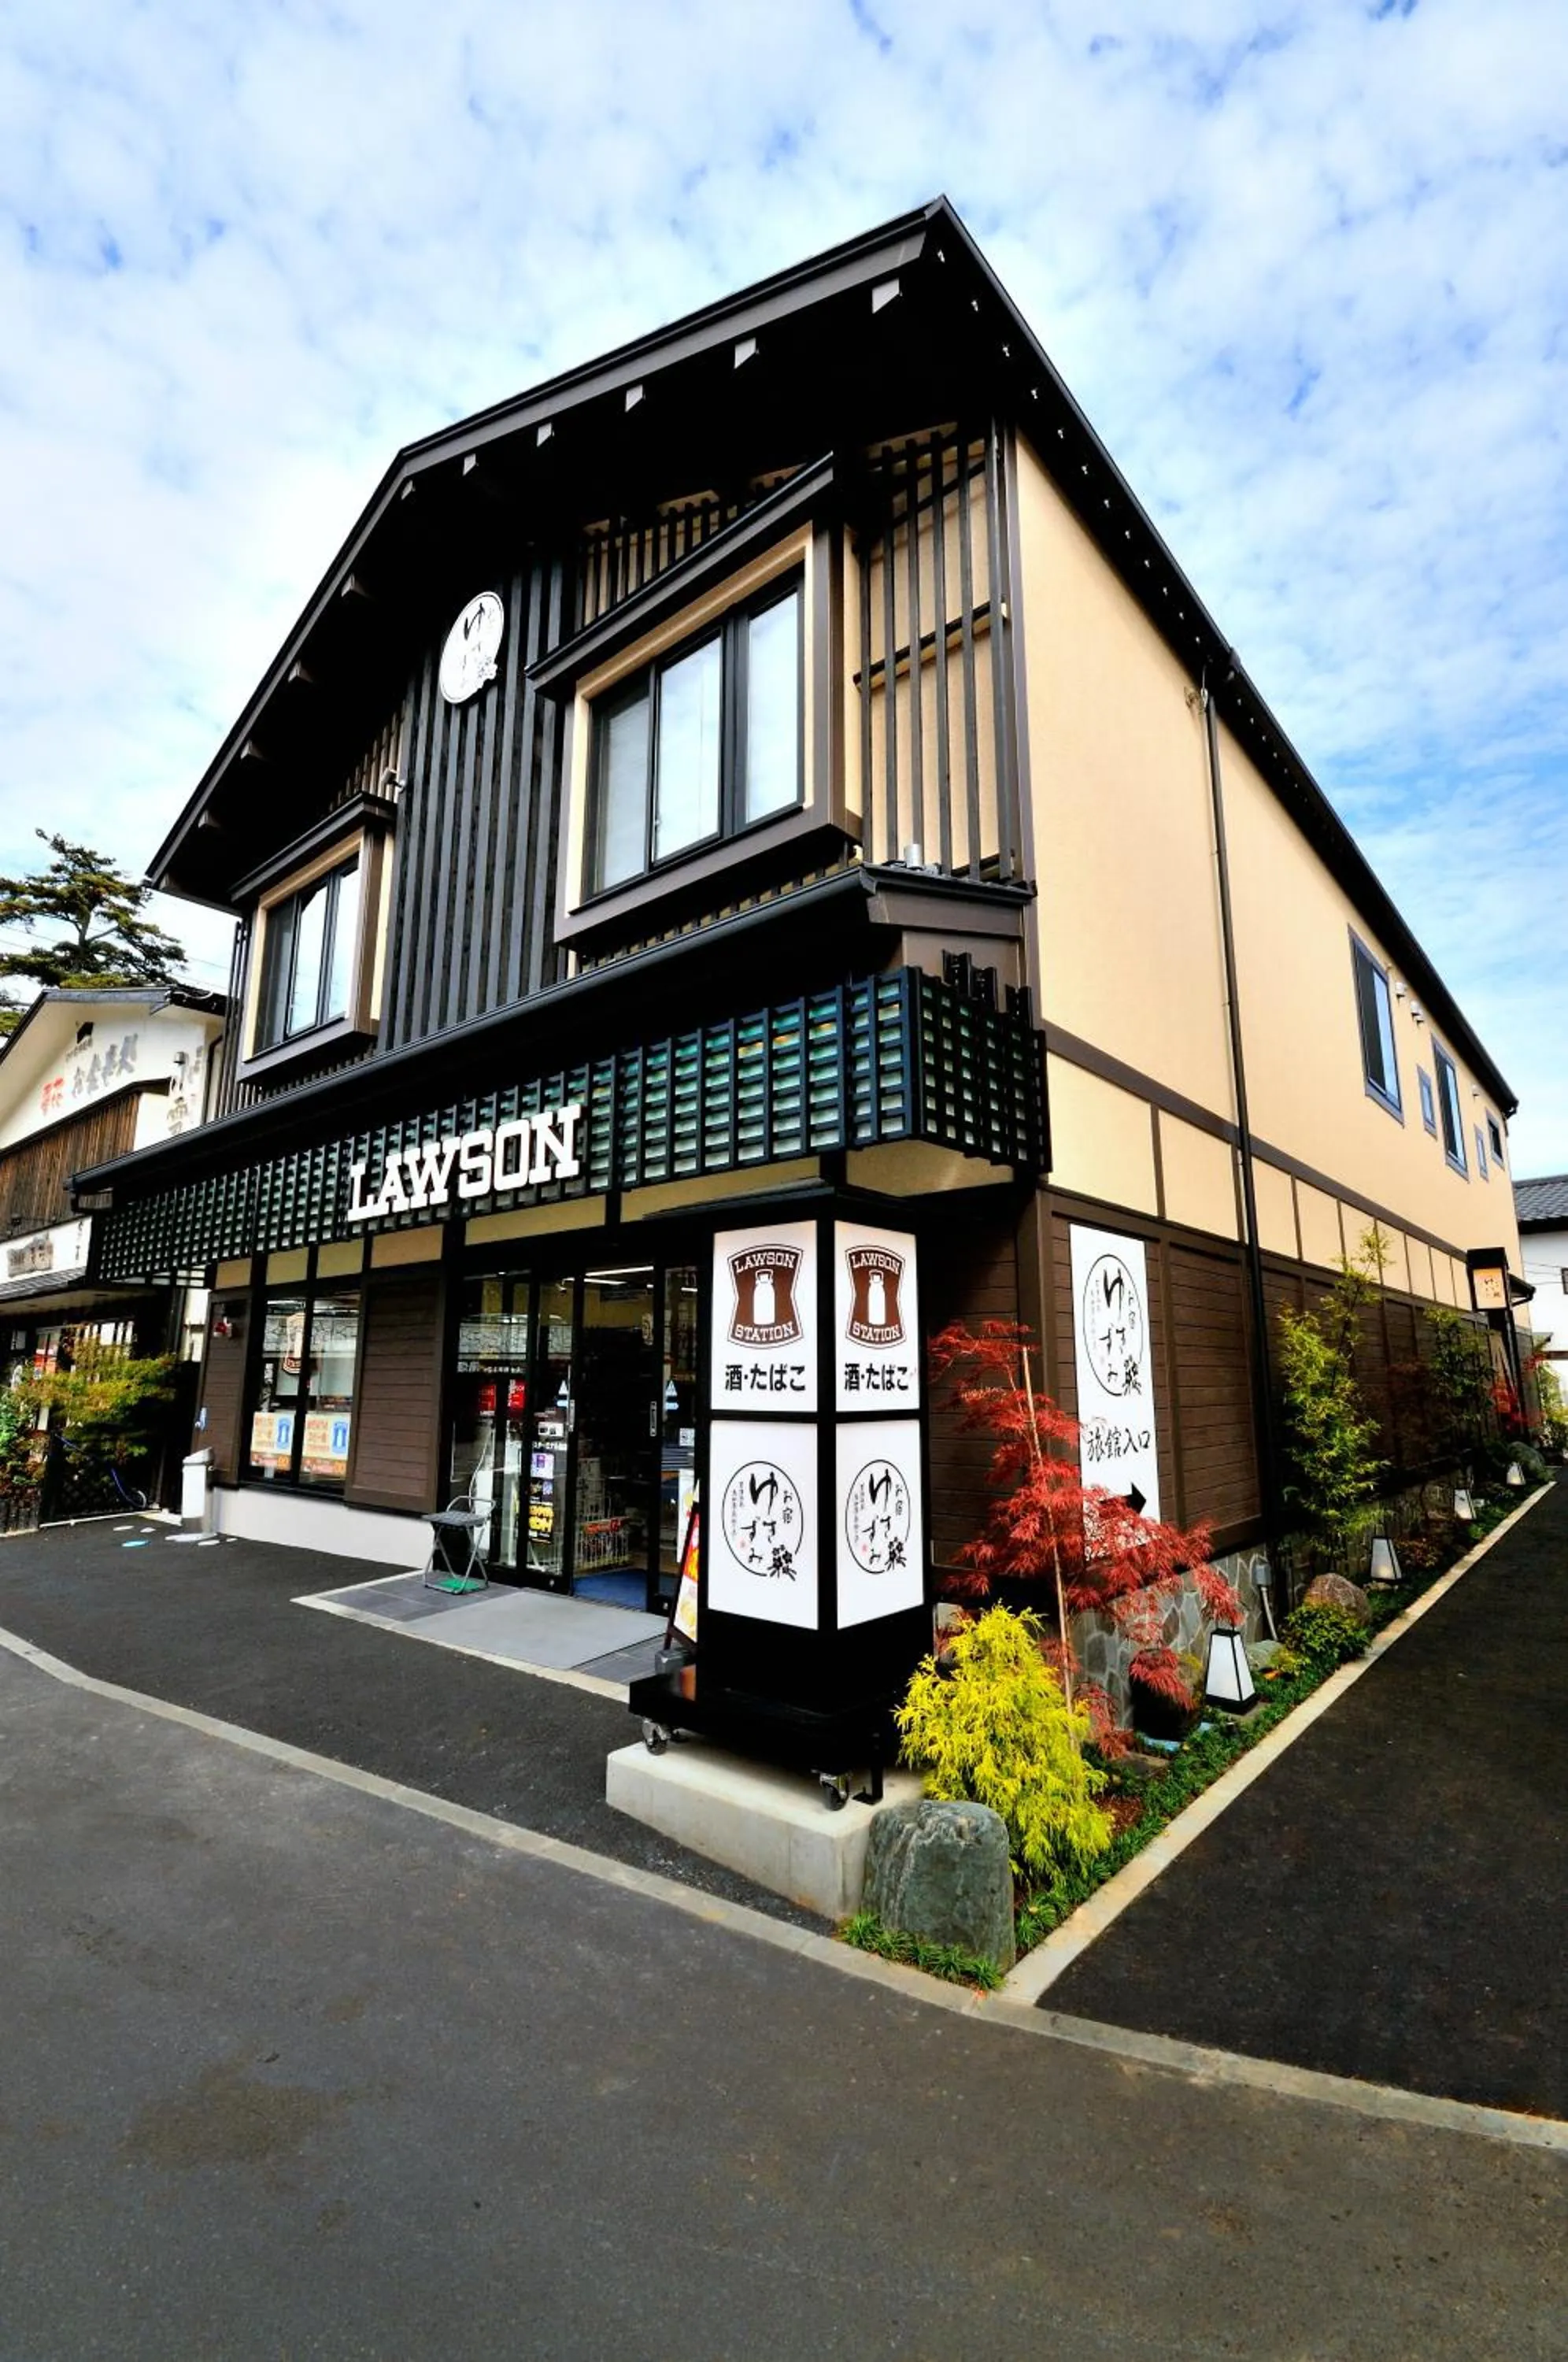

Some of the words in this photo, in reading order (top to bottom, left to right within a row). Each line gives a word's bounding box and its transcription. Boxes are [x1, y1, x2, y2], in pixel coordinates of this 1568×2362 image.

[347, 1104, 580, 1221] LAWSON
[734, 1251, 796, 1274] LAWSON
[852, 1253, 900, 1275] LAWSON
[734, 1320, 795, 1342] STATION
[852, 1320, 901, 1342] STATION
